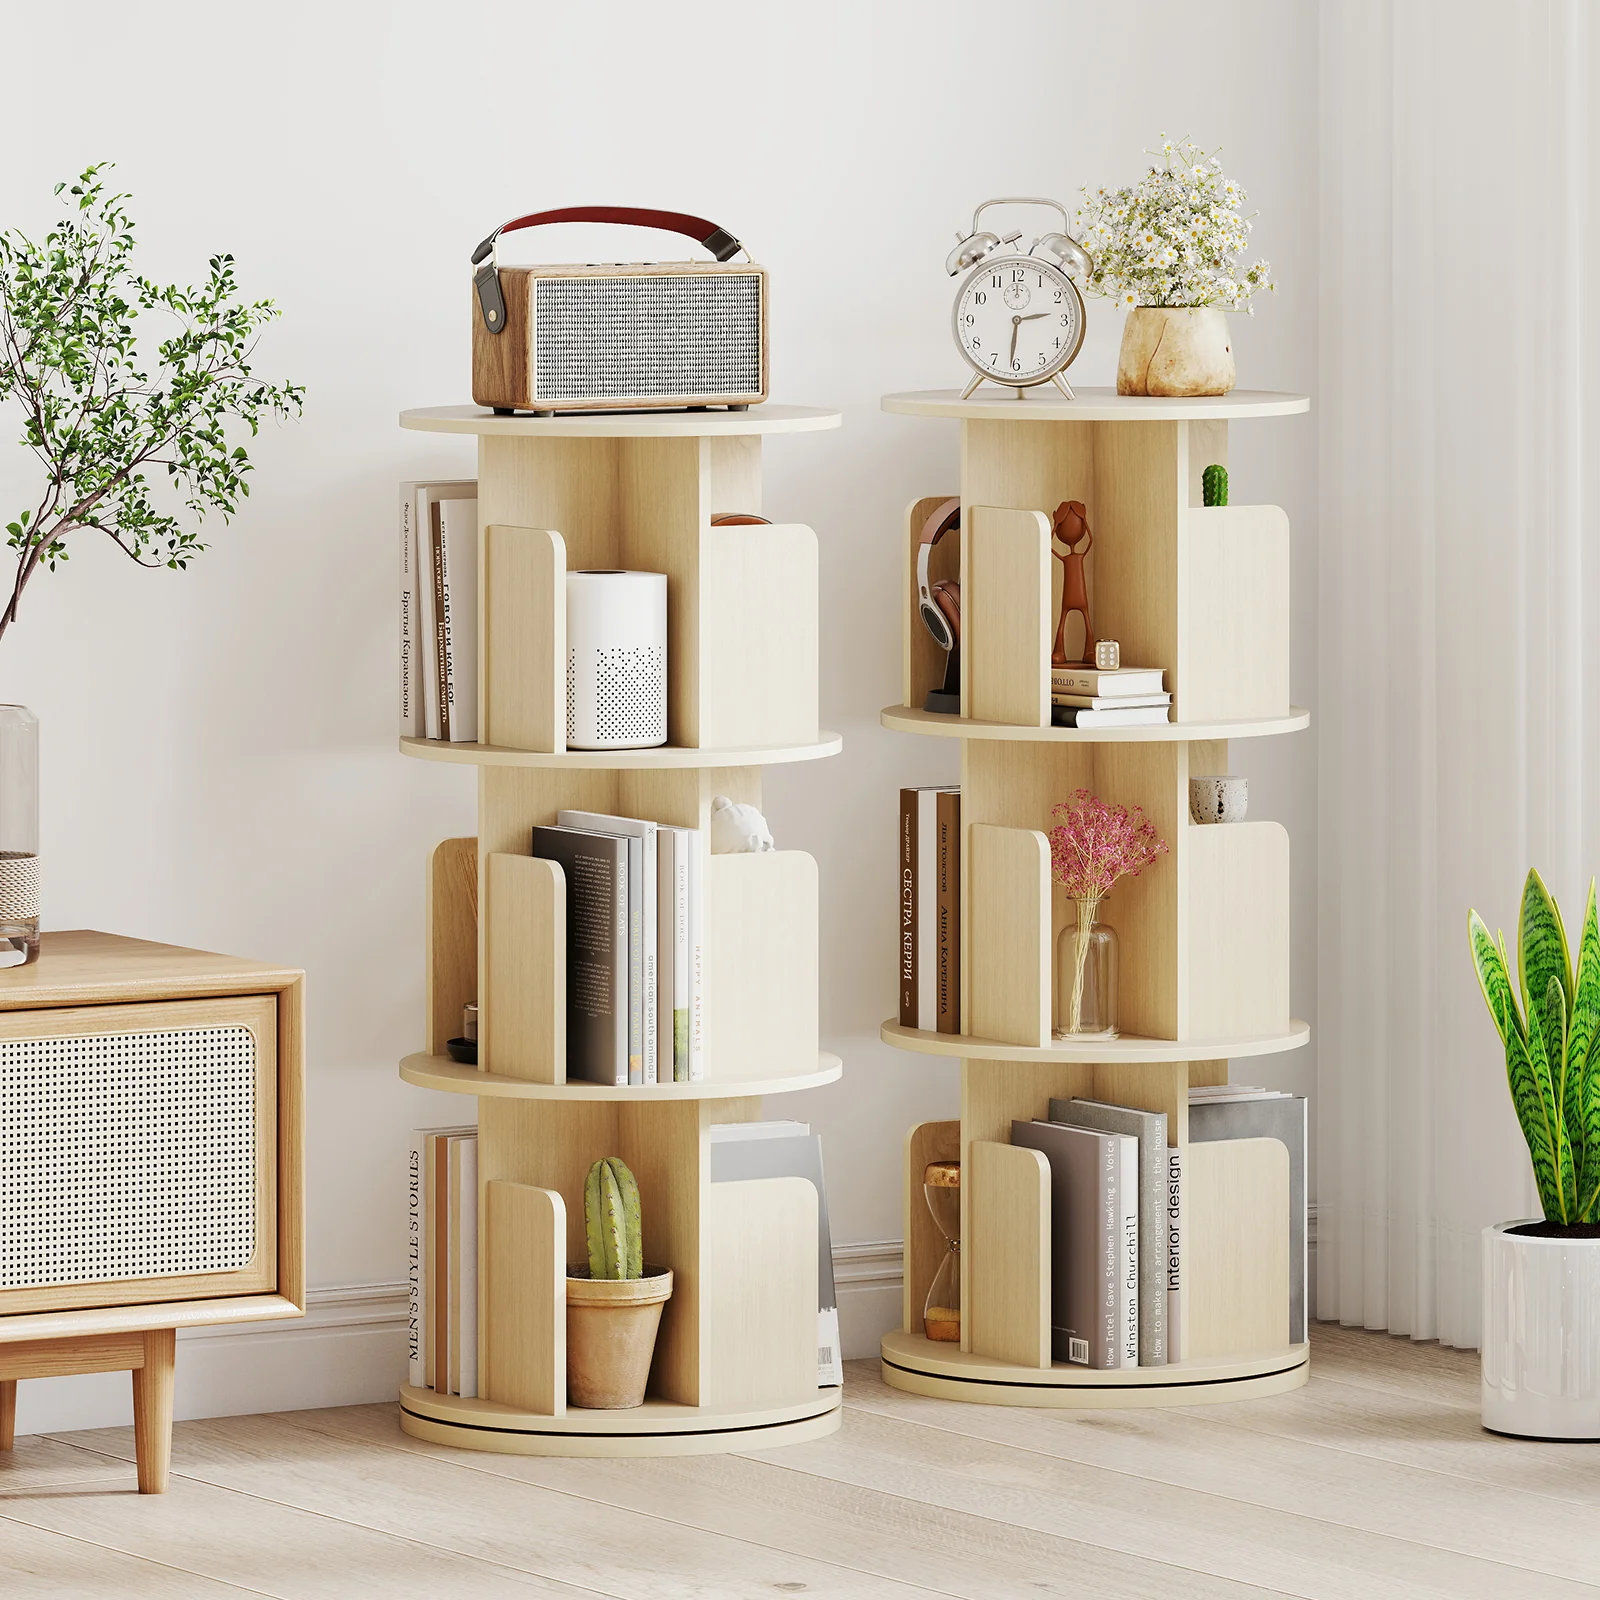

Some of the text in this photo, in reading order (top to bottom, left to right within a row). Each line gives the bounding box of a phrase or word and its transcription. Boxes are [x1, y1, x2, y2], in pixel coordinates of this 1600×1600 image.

[991, 275, 1002, 288] 11
[1012, 269, 1025, 282] 12
[1037, 275, 1042, 288] 1
[974, 291, 986, 305] 10
[1053, 291, 1062, 304] 2
[966, 314, 974, 327] 9
[1060, 314, 1068, 327] 3
[972, 336, 981, 349] 8
[1052, 337, 1061, 349] 4
[990, 353, 998, 366] 7
[1012, 358, 1021, 371] 6
[1038, 353, 1046, 365] 5
[443, 584, 451, 646] ГОВОРИ
[401, 590, 411, 719] Братья Карамазовы
[437, 621, 448, 723] Бархатная смерть
[619, 894, 626, 908] OF
[679, 897, 685, 912] OF
[903, 868, 913, 981] СЕСТРА КЕРРИ
[632, 949, 639, 962] OF
[941, 906, 949, 1015] АННА КАРЕНИНА
[647, 955, 656, 1079] american south animals
[1105, 1140, 1115, 1171] Voice
[1105, 1187, 1117, 1230] Hawking
[1166, 1155, 1182, 1291] Interior design
[1152, 1119, 1165, 1358] How to make an arrangement in the house
[409, 1150, 419, 1361] MEN'S STYLE STORIES
[1105, 1235, 1117, 1277] Stephen
[1106, 1282, 1115, 1307] Gave
[1125, 1213, 1137, 1359] Winston Churchill
[1105, 1312, 1115, 1343] Intel
[1106, 1346, 1115, 1366] How
